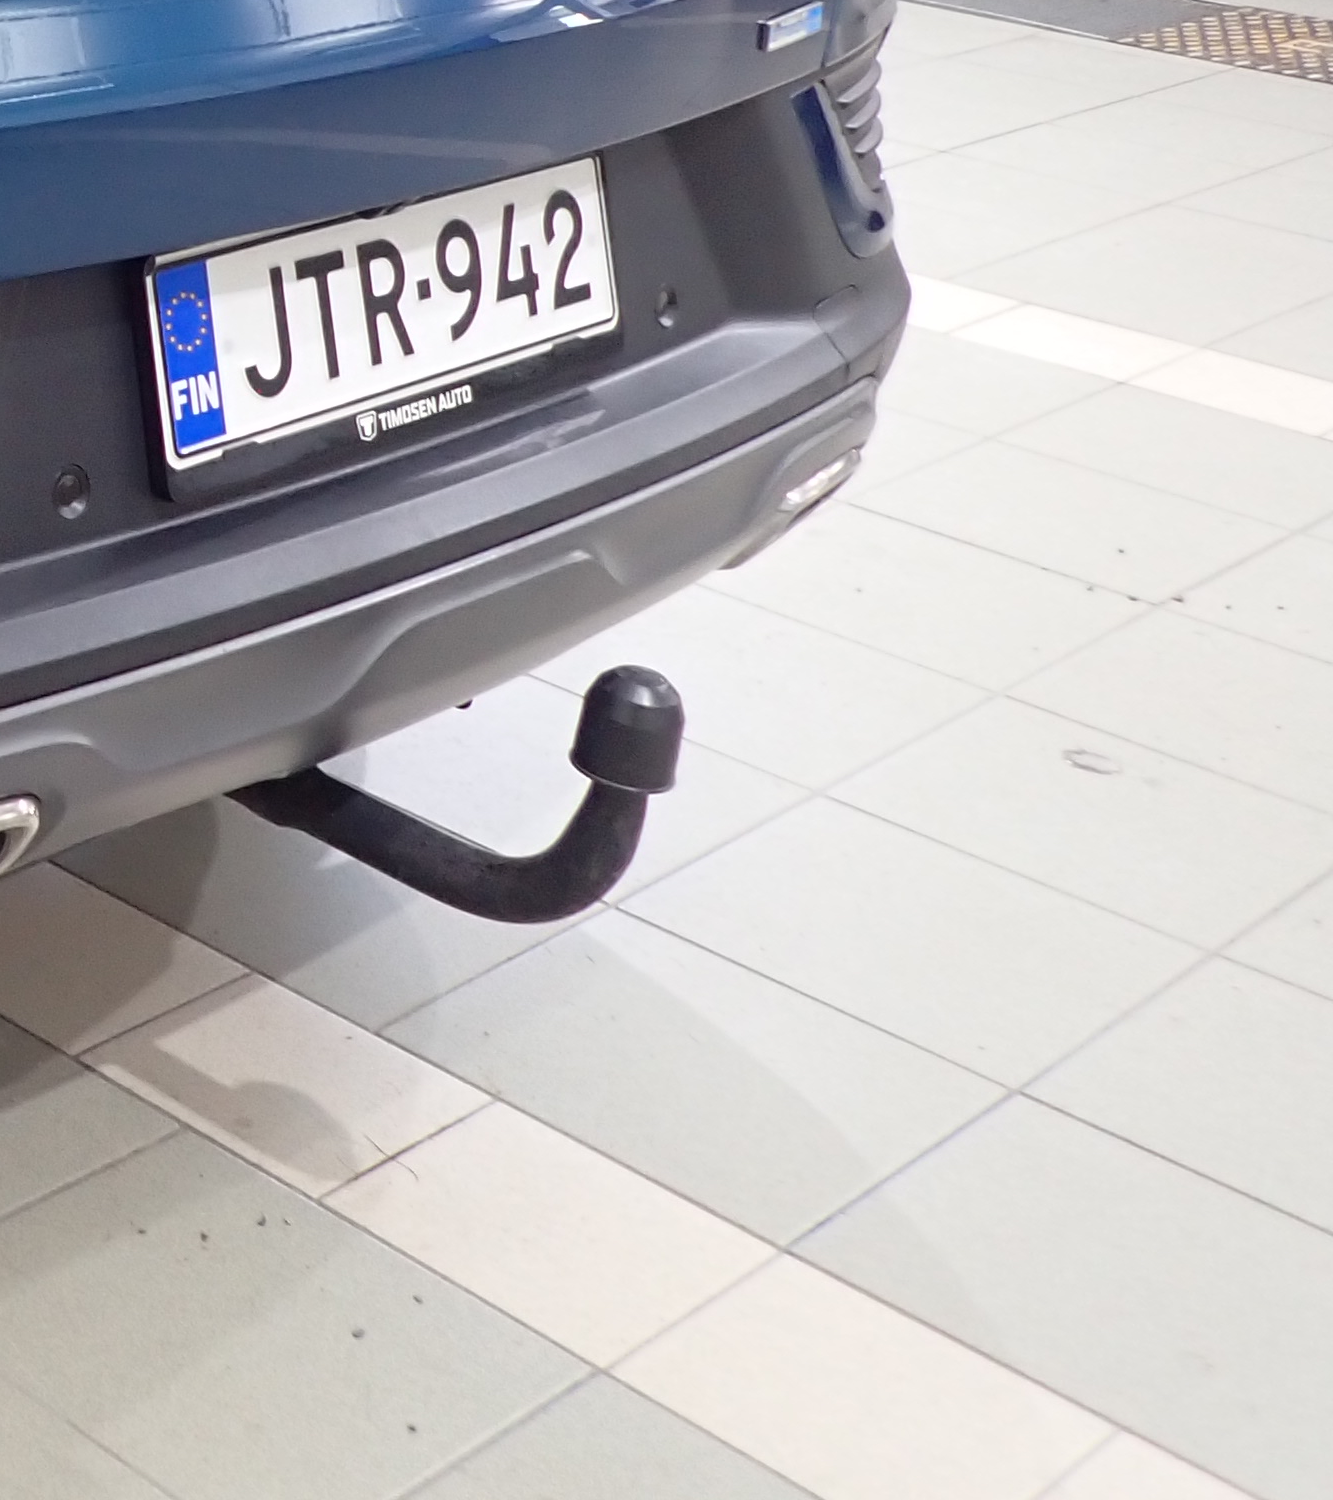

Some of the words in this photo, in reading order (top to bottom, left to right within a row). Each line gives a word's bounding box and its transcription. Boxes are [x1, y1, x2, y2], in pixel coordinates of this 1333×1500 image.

[244, 189, 592, 399] JTR-942
[170, 371, 221, 421] FIN
[378, 396, 438, 431] TIMOSEN
[438, 384, 473, 412] AUTO
